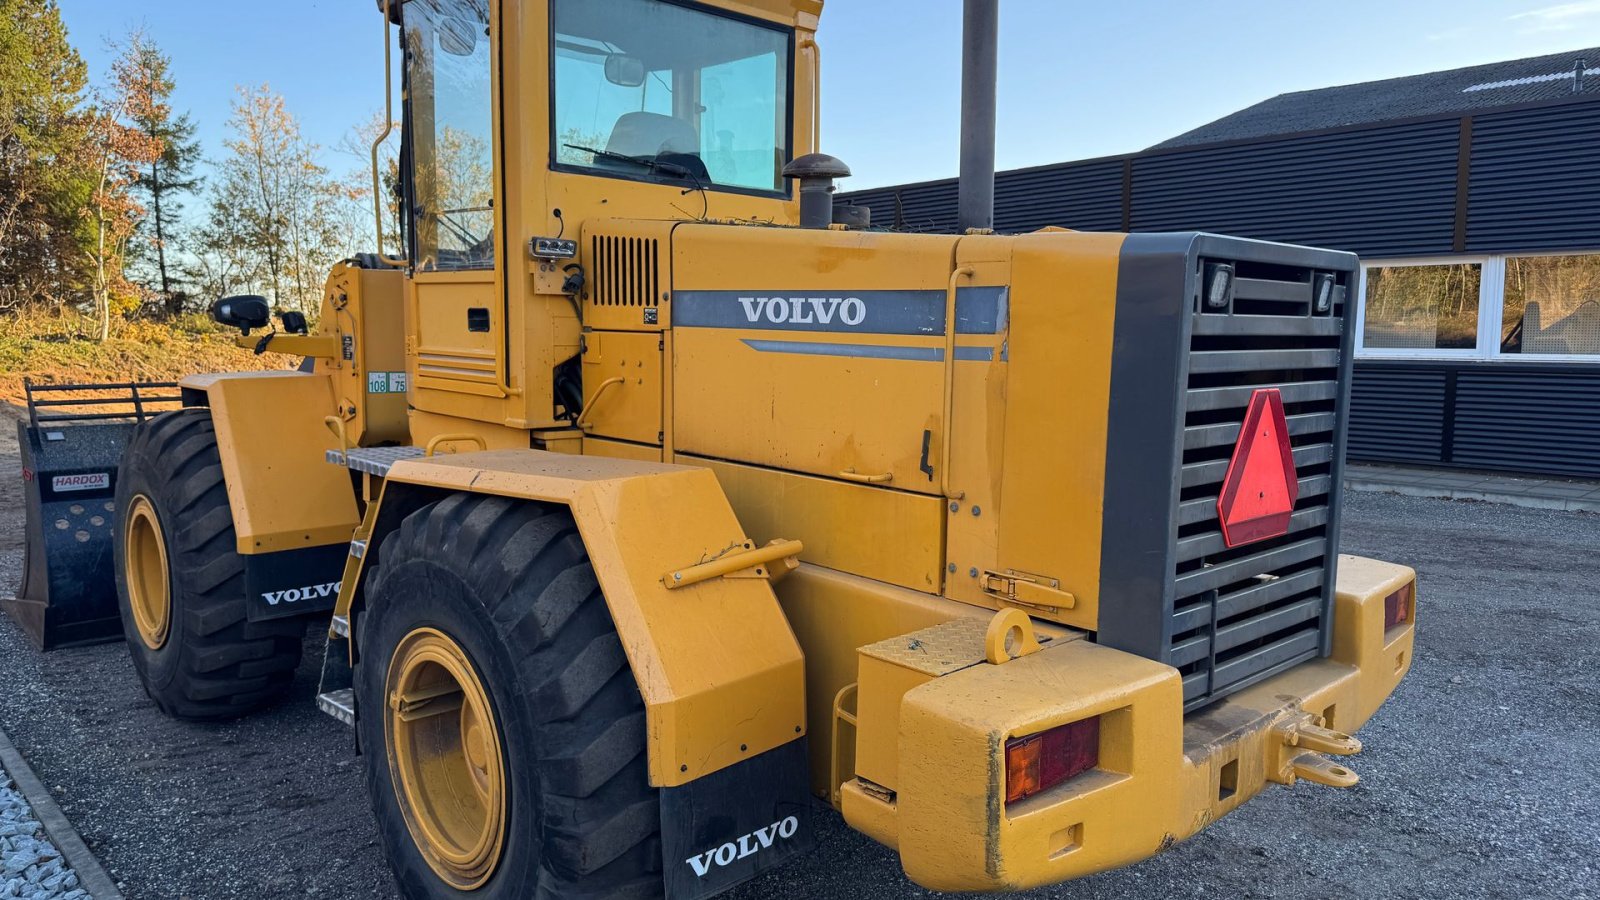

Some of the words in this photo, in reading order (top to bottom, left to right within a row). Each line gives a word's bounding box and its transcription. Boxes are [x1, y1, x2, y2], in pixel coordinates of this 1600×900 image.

[738, 297, 867, 326] VOLVO
[369, 380, 386, 392] 108
[394, 380, 405, 391] 75
[55, 474, 104, 486] HARDOX
[685, 816, 799, 877] VOLVO
